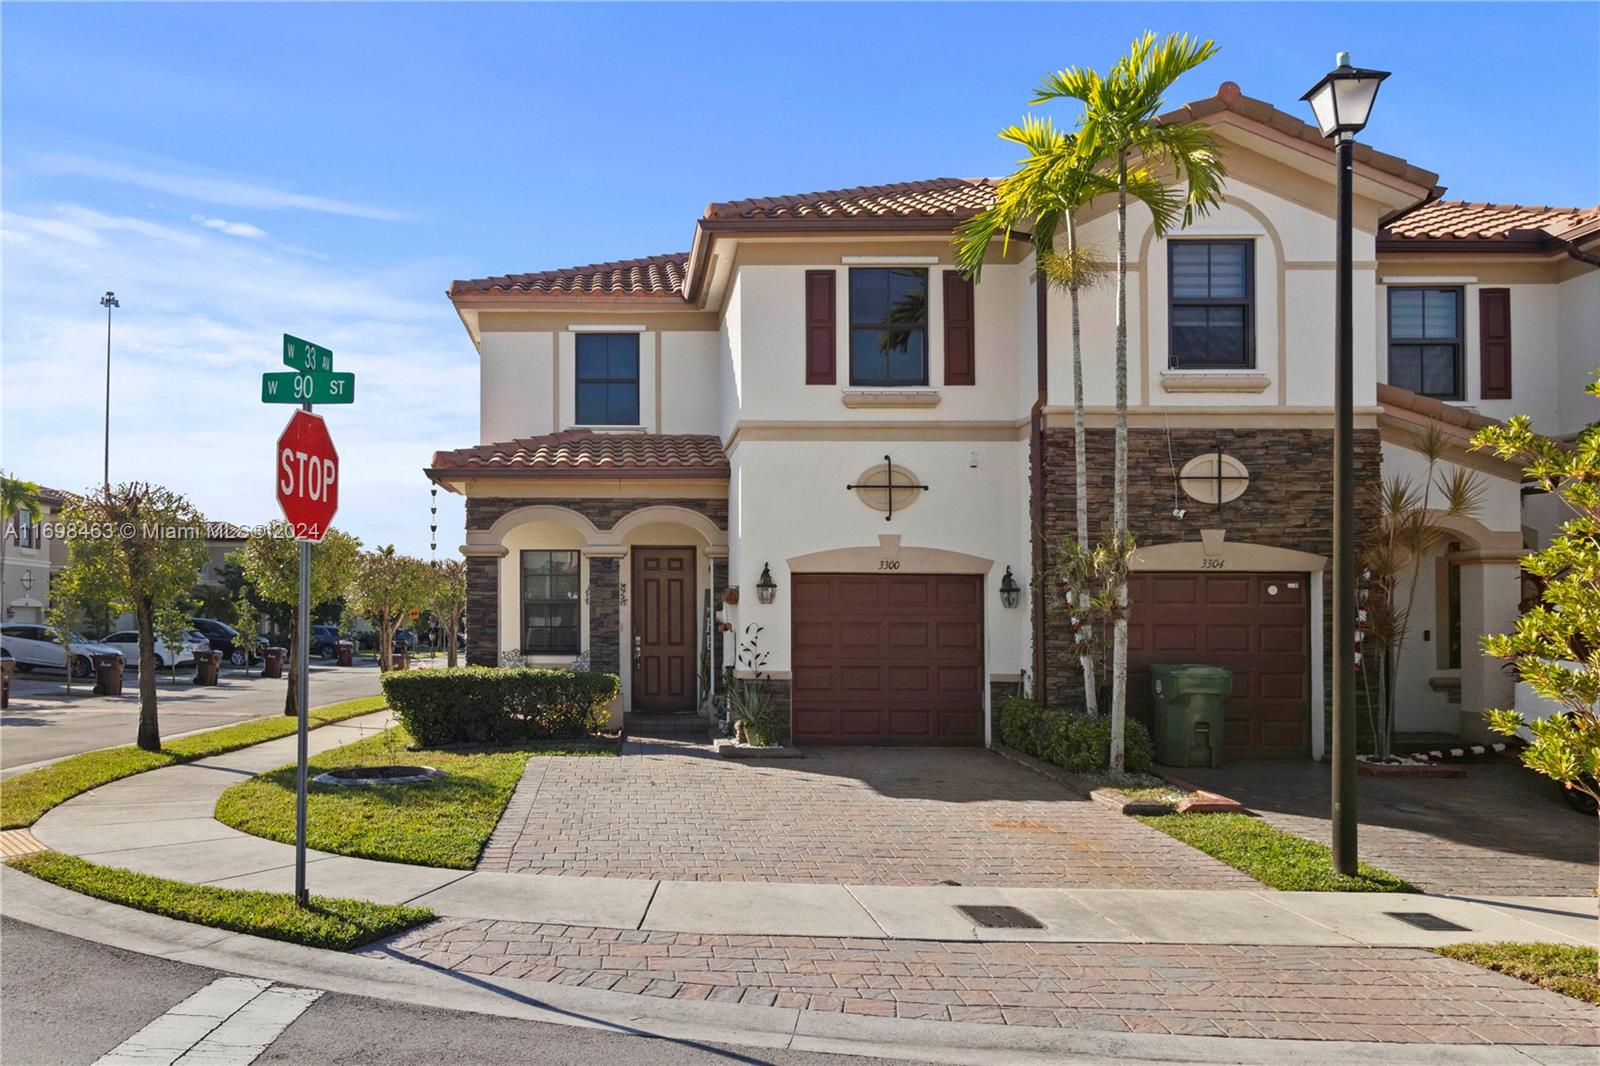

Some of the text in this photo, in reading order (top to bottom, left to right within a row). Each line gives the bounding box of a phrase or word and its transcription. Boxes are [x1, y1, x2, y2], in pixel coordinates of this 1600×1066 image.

[287, 343, 330, 371] W 33 AV
[267, 375, 345, 399] W 90 ST
[280, 447, 336, 503] STOP
[878, 560, 901, 570] 3300
[1200, 558, 1225, 569] 3304
